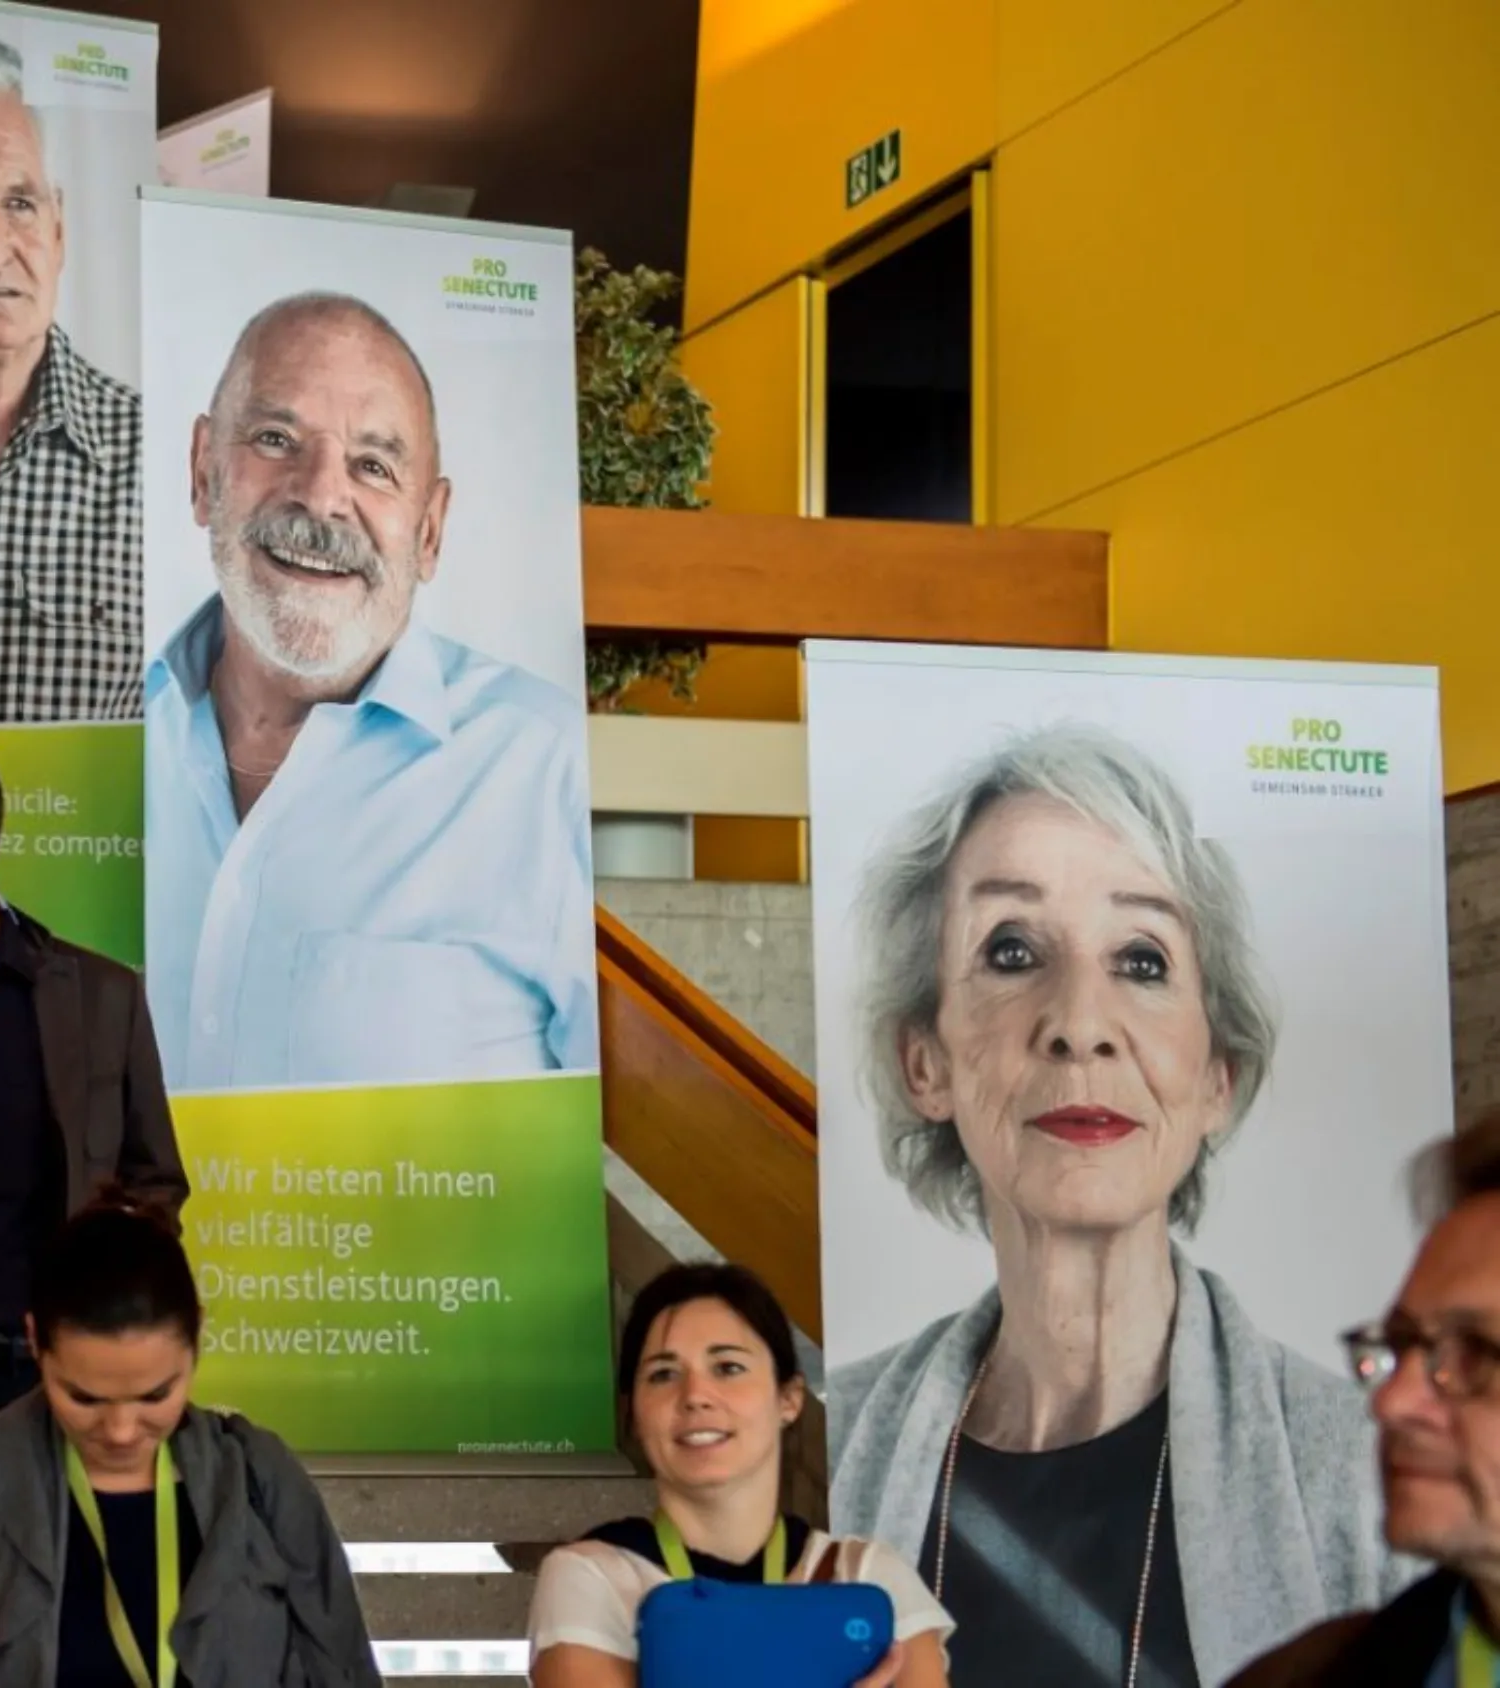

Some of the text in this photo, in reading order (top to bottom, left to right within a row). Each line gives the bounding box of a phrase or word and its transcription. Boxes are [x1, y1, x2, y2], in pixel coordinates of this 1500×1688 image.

[473, 257, 507, 277] PRO
[1291, 718, 1342, 743] PRO
[1246, 745, 1388, 775] SENECTUTE
[197, 1157, 496, 1197] Wir bieten Ihnen
[197, 1210, 374, 1259] vielfältige
[198, 1263, 512, 1312] Dienstleistungen.
[202, 1318, 430, 1355] Schweizweit.
